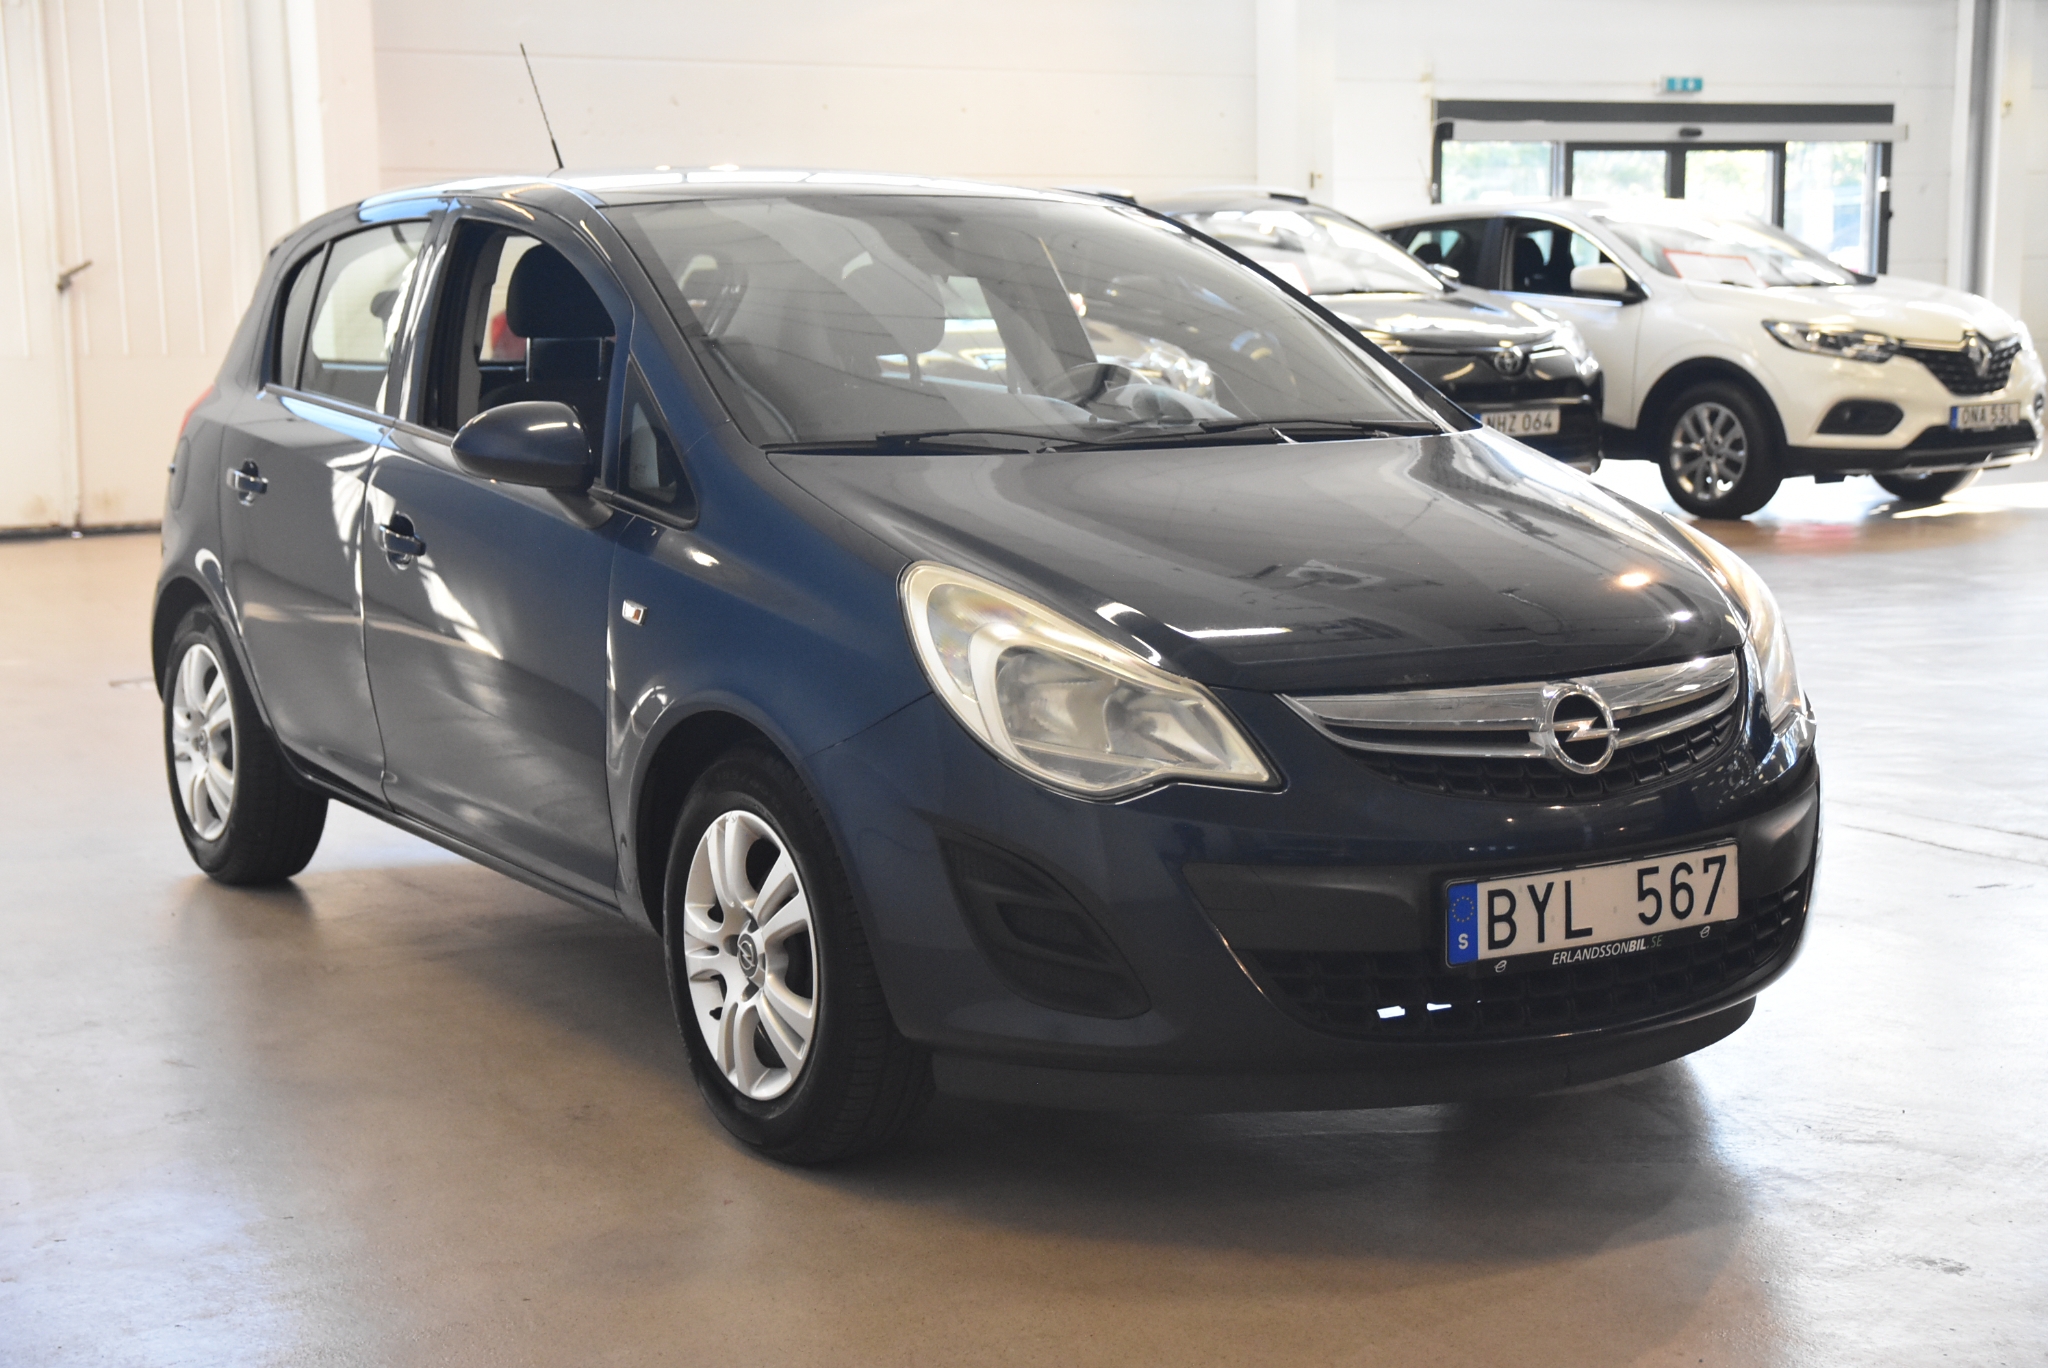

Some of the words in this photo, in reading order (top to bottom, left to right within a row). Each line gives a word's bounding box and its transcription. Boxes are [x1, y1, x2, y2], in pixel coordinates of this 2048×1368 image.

[1522, 412, 1552, 431] 064
[1487, 879, 1593, 950] BYL
[1637, 854, 1727, 926] 567
[1457, 933, 1469, 950] S
[1551, 936, 1663, 965] ERLANDSSONBIL.SE
